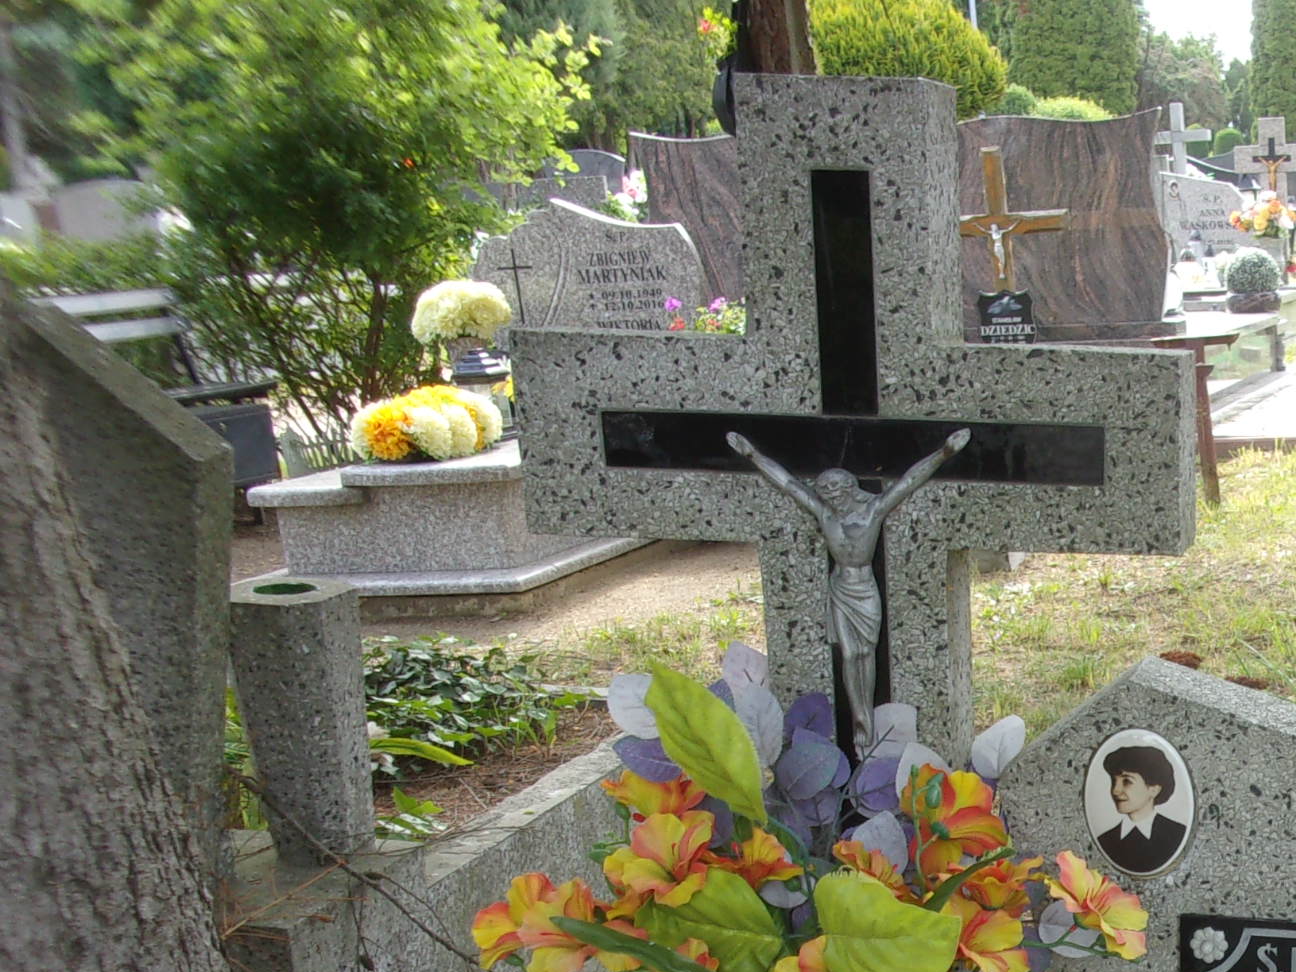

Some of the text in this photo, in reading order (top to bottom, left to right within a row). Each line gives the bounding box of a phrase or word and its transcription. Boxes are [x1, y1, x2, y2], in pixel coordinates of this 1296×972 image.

[588, 250, 650, 268] ZBIGNIEW
[578, 265, 668, 285] MARTYNIAK
[981, 324, 1035, 337] DZIEDZIC
